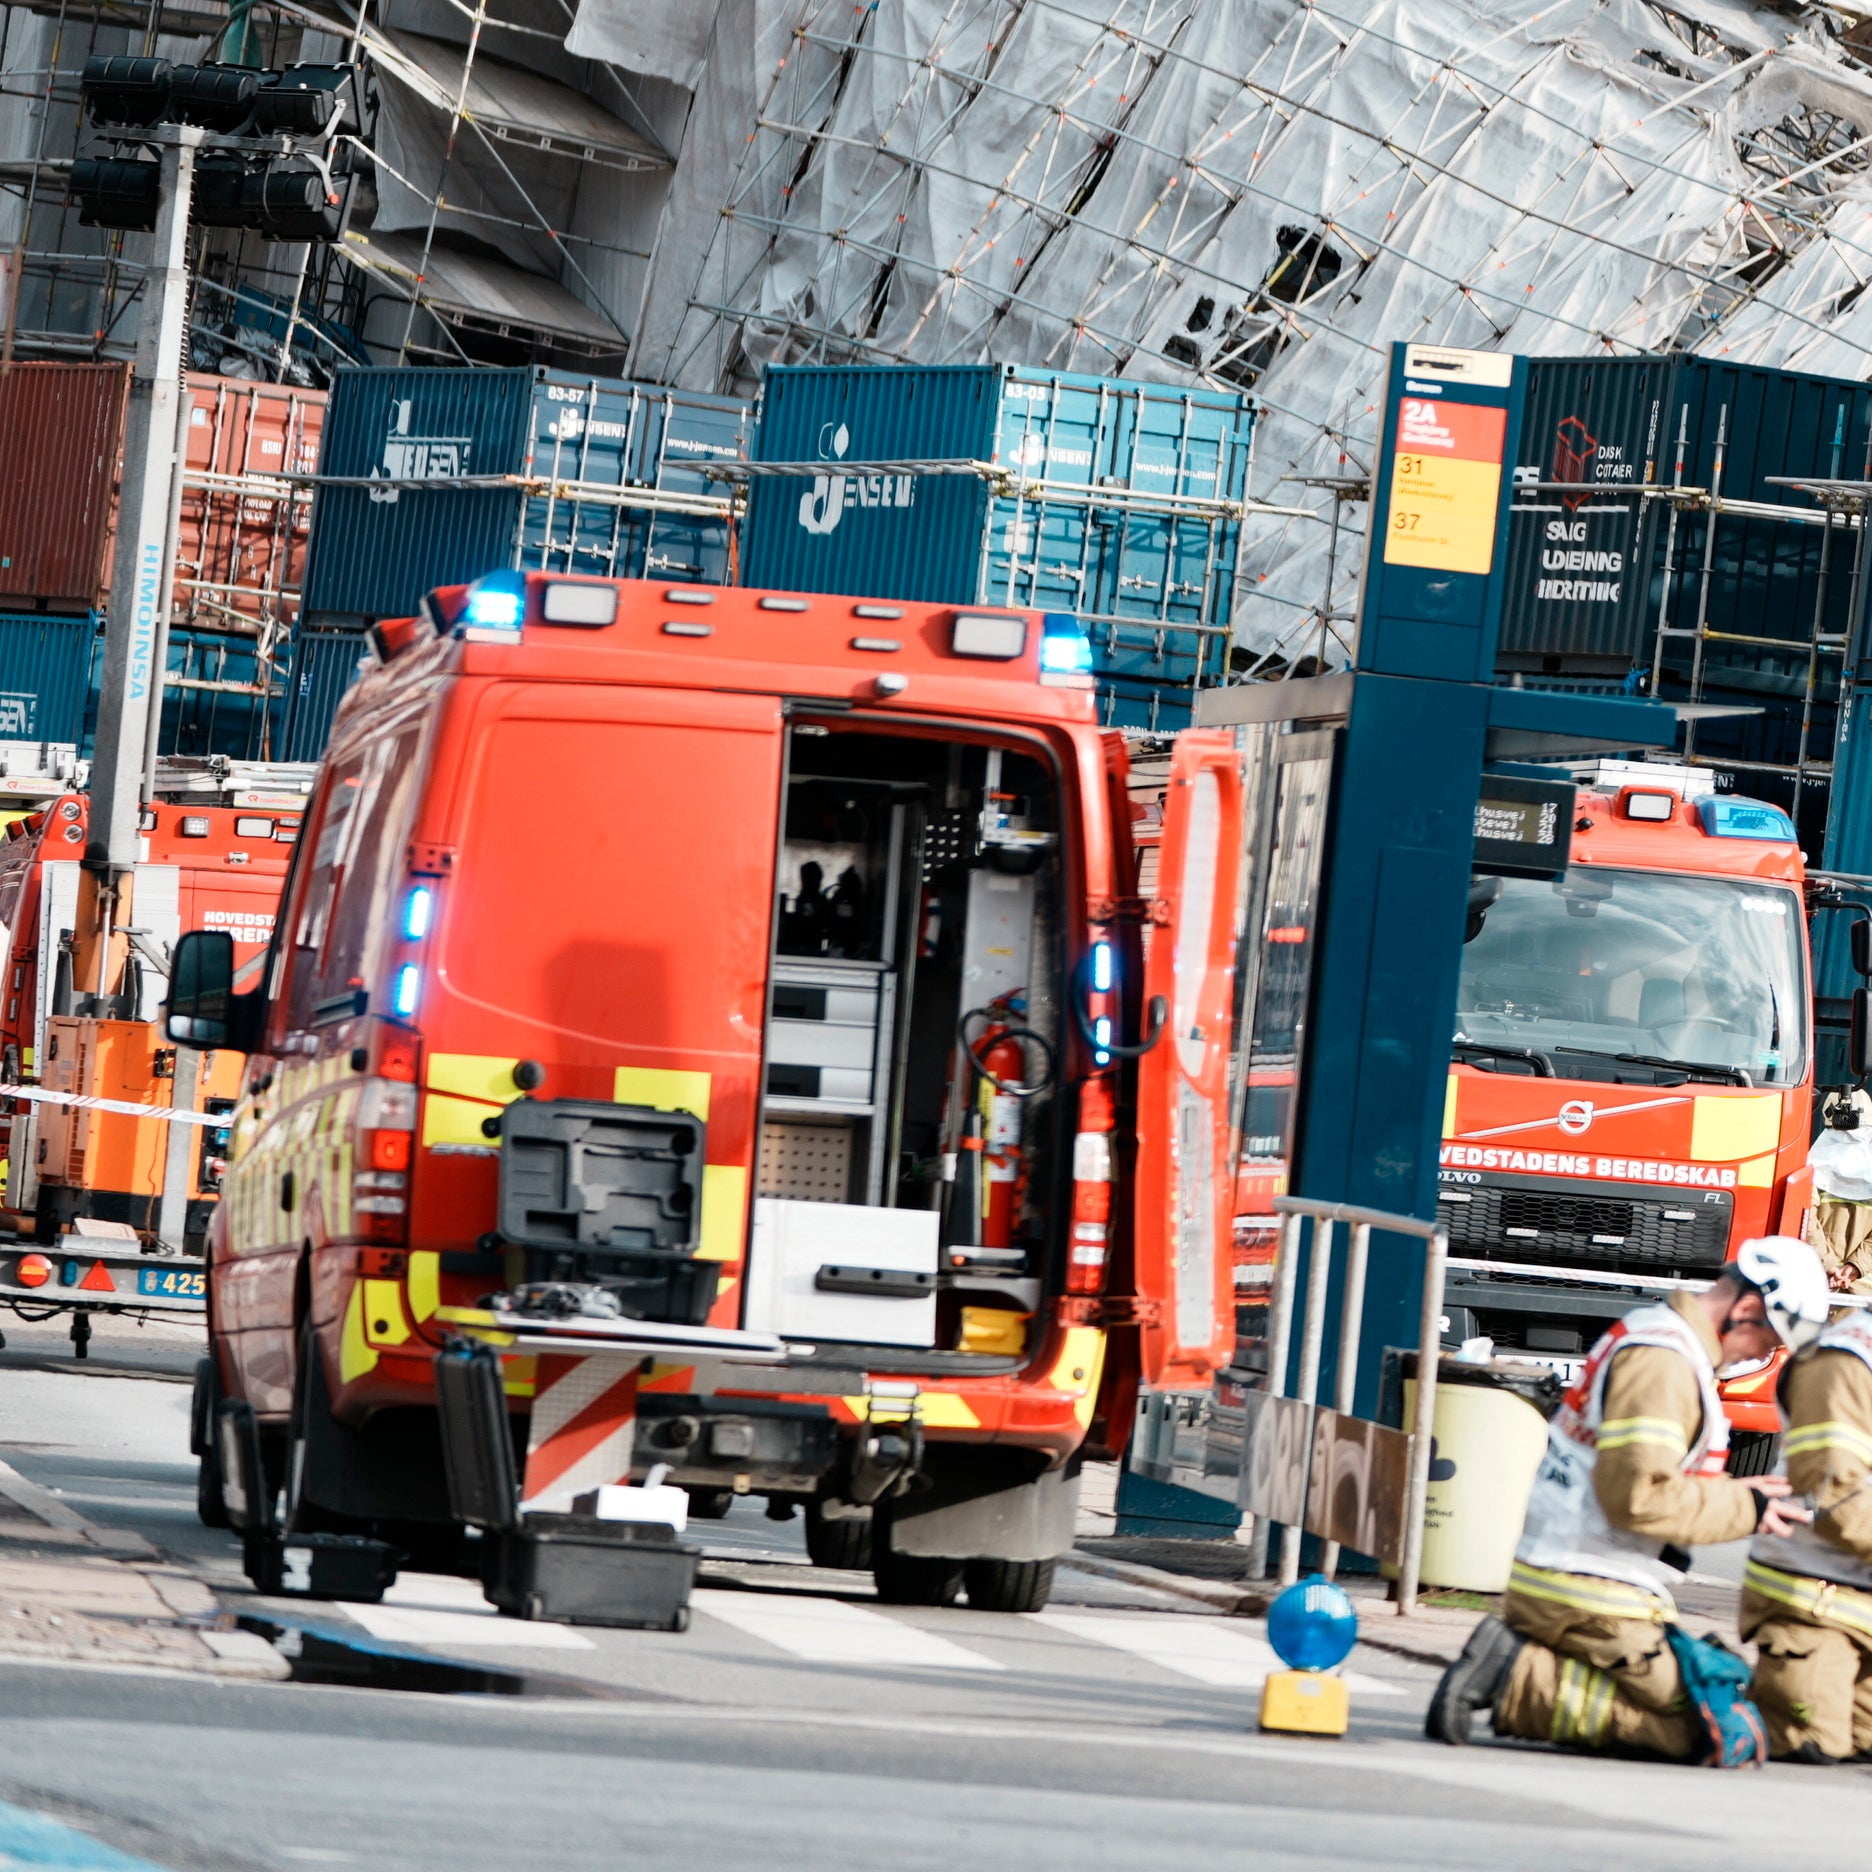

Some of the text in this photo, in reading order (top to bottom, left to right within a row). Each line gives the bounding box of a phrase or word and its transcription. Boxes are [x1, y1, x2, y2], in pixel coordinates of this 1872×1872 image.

[1006, 382, 1046, 401] 83-05
[1404, 401, 1437, 425] 2A
[1400, 456, 1423, 476] 31
[1395, 511, 1421, 531] 37
[129, 544, 160, 700] HIMOINSA
[204, 911, 276, 927] HOVEDST
[1596, 1157, 1737, 1188] BEREDSKAB
[1703, 1192, 1725, 1205] FL
